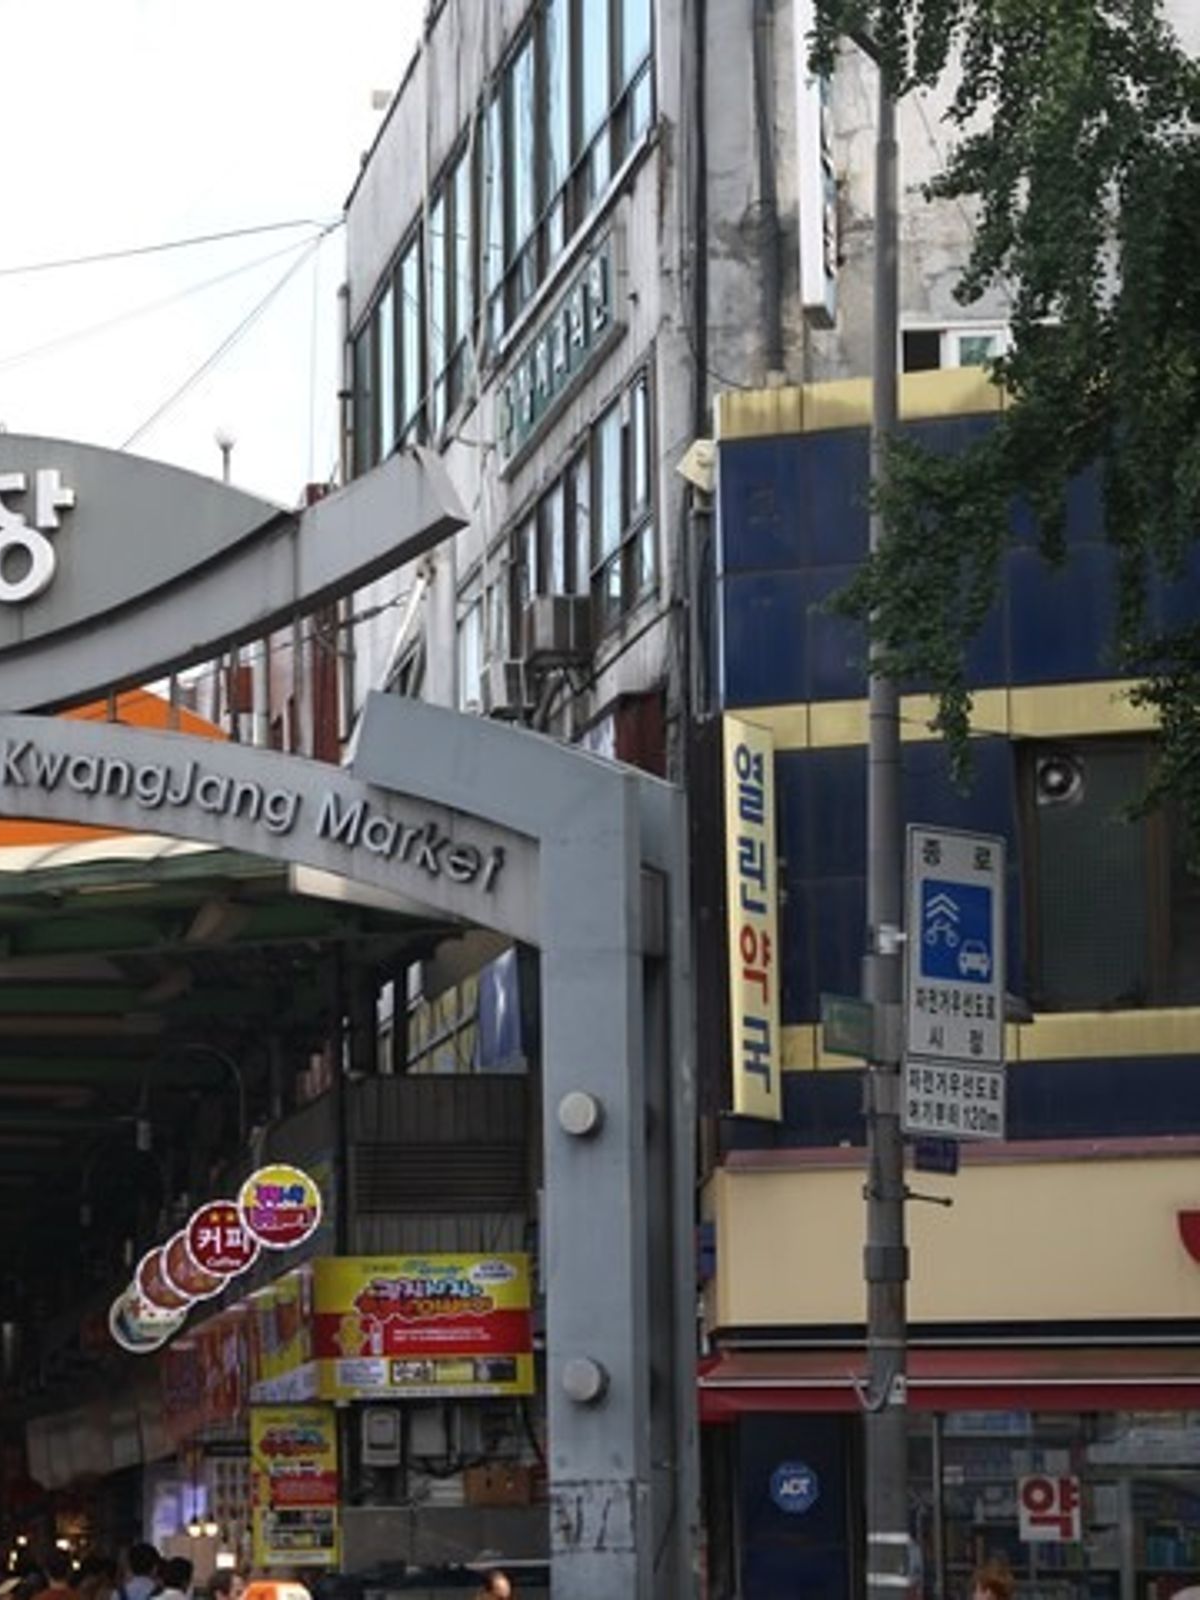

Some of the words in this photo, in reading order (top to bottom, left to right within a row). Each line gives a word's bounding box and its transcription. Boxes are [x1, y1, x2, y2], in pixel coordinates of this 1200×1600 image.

[0, 739, 300, 835] KwangJang
[315, 792, 508, 893] Market
[197, 1225, 250, 1255] 커피
[1022, 1477, 1078, 1539] 약
